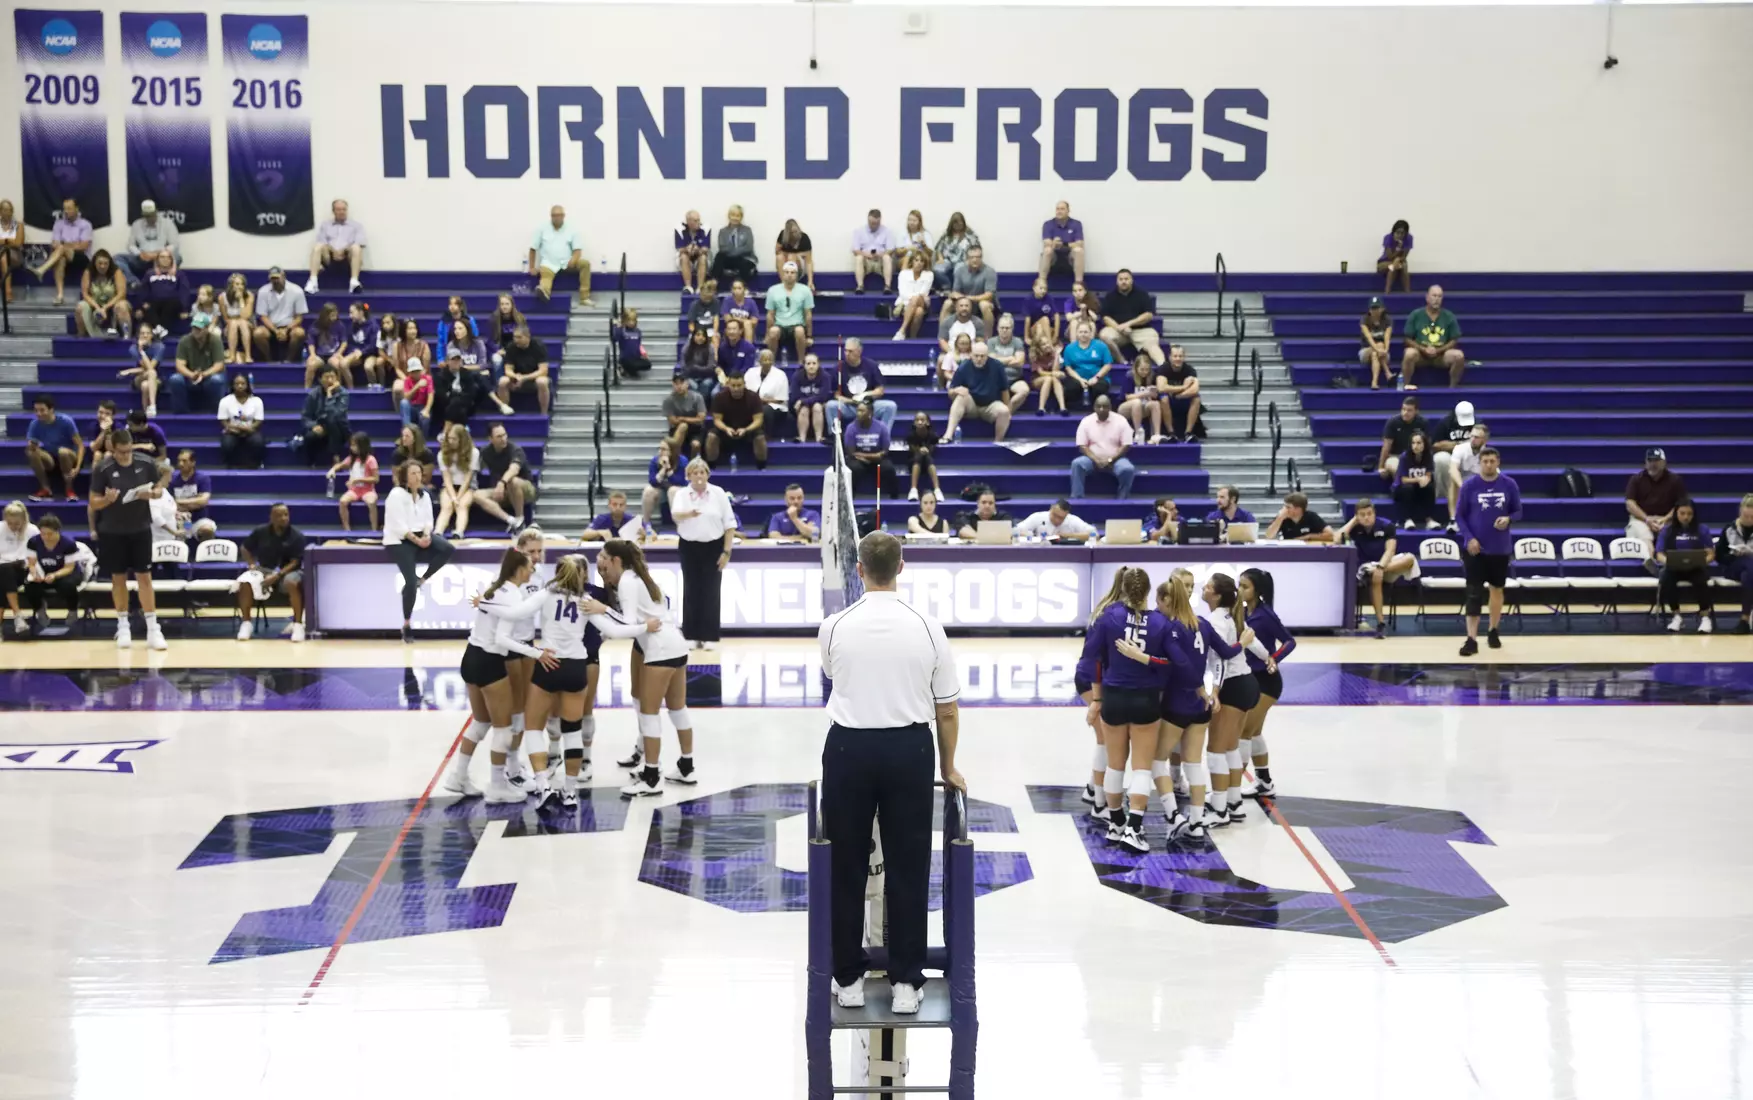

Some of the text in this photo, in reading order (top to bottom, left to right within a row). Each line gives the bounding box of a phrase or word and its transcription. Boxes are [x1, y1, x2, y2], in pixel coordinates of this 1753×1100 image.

[45, 35, 78, 47] NCAA
[150, 37, 182, 49] NCAA
[251, 40, 282, 52] NCAA
[24, 73, 100, 105] 2009
[131, 75, 203, 107] 2015
[232, 78, 303, 109] 2016
[380, 84, 1270, 182] HORNED FROGS
[256, 212, 287, 227] TCU
[156, 544, 181, 557] TCU
[206, 543, 230, 556] TCU
[1425, 541, 1453, 555] TCU
[1520, 541, 1547, 555] TCU
[1570, 541, 1595, 555] TCU
[1617, 541, 1643, 554] TCU
[555, 599, 579, 624] 14
[1123, 626, 1148, 653] 15
[1193, 631, 1205, 655] 4
